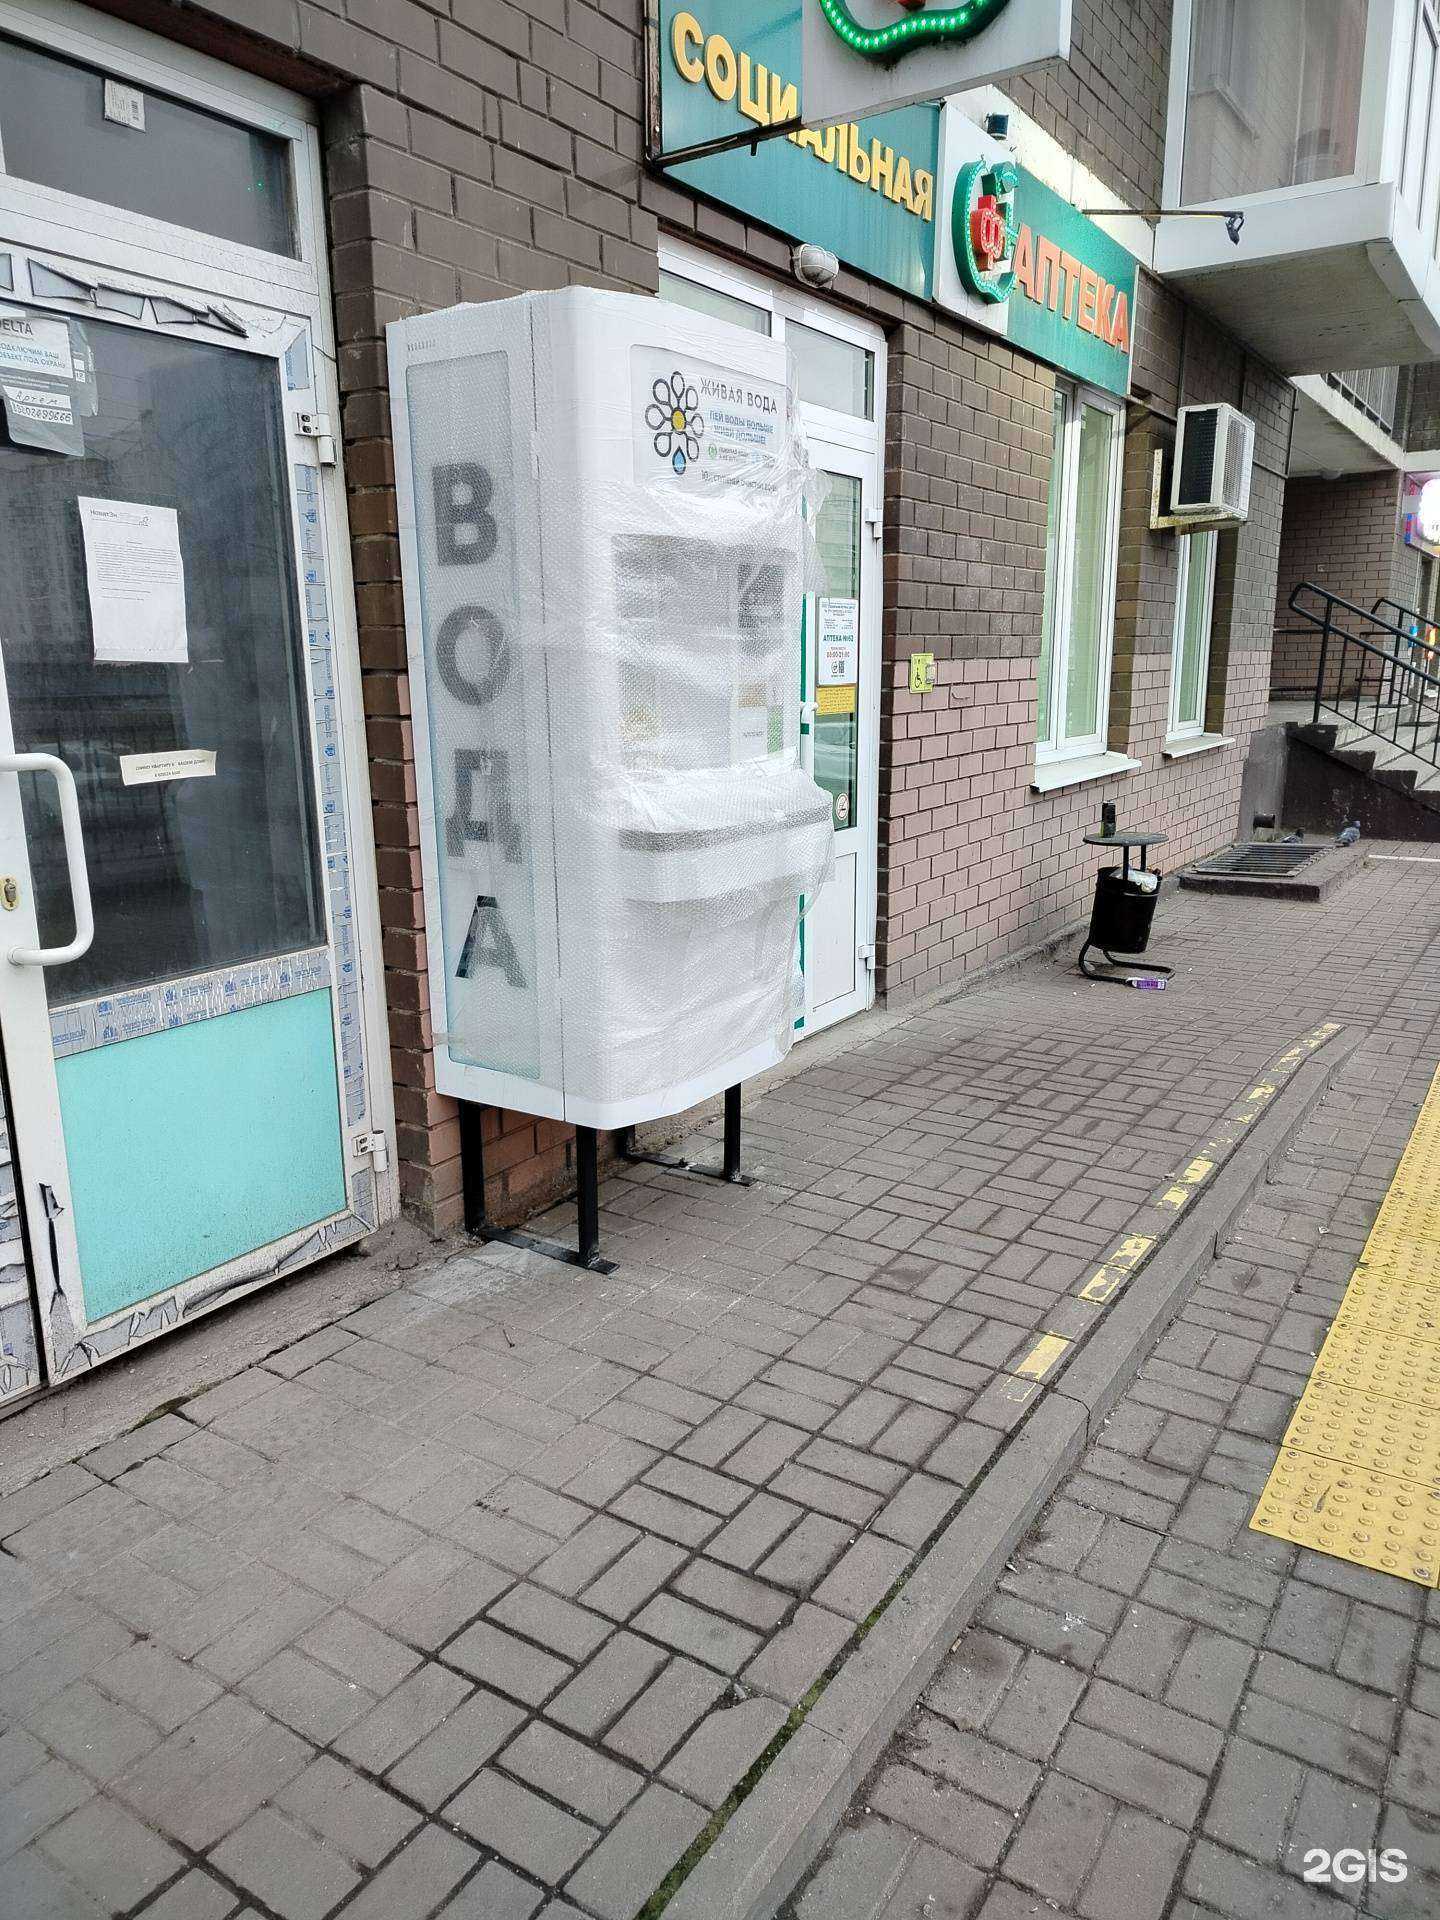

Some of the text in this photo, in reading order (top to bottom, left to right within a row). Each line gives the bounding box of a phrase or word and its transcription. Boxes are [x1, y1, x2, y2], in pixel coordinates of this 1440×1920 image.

[0, 318, 33, 335] ELTA
[1011, 222, 1130, 354] АПТЕКА
[700, 377, 777, 414] ЖИВАЯ ВОДА
[431, 461, 528, 989] ВОДА
